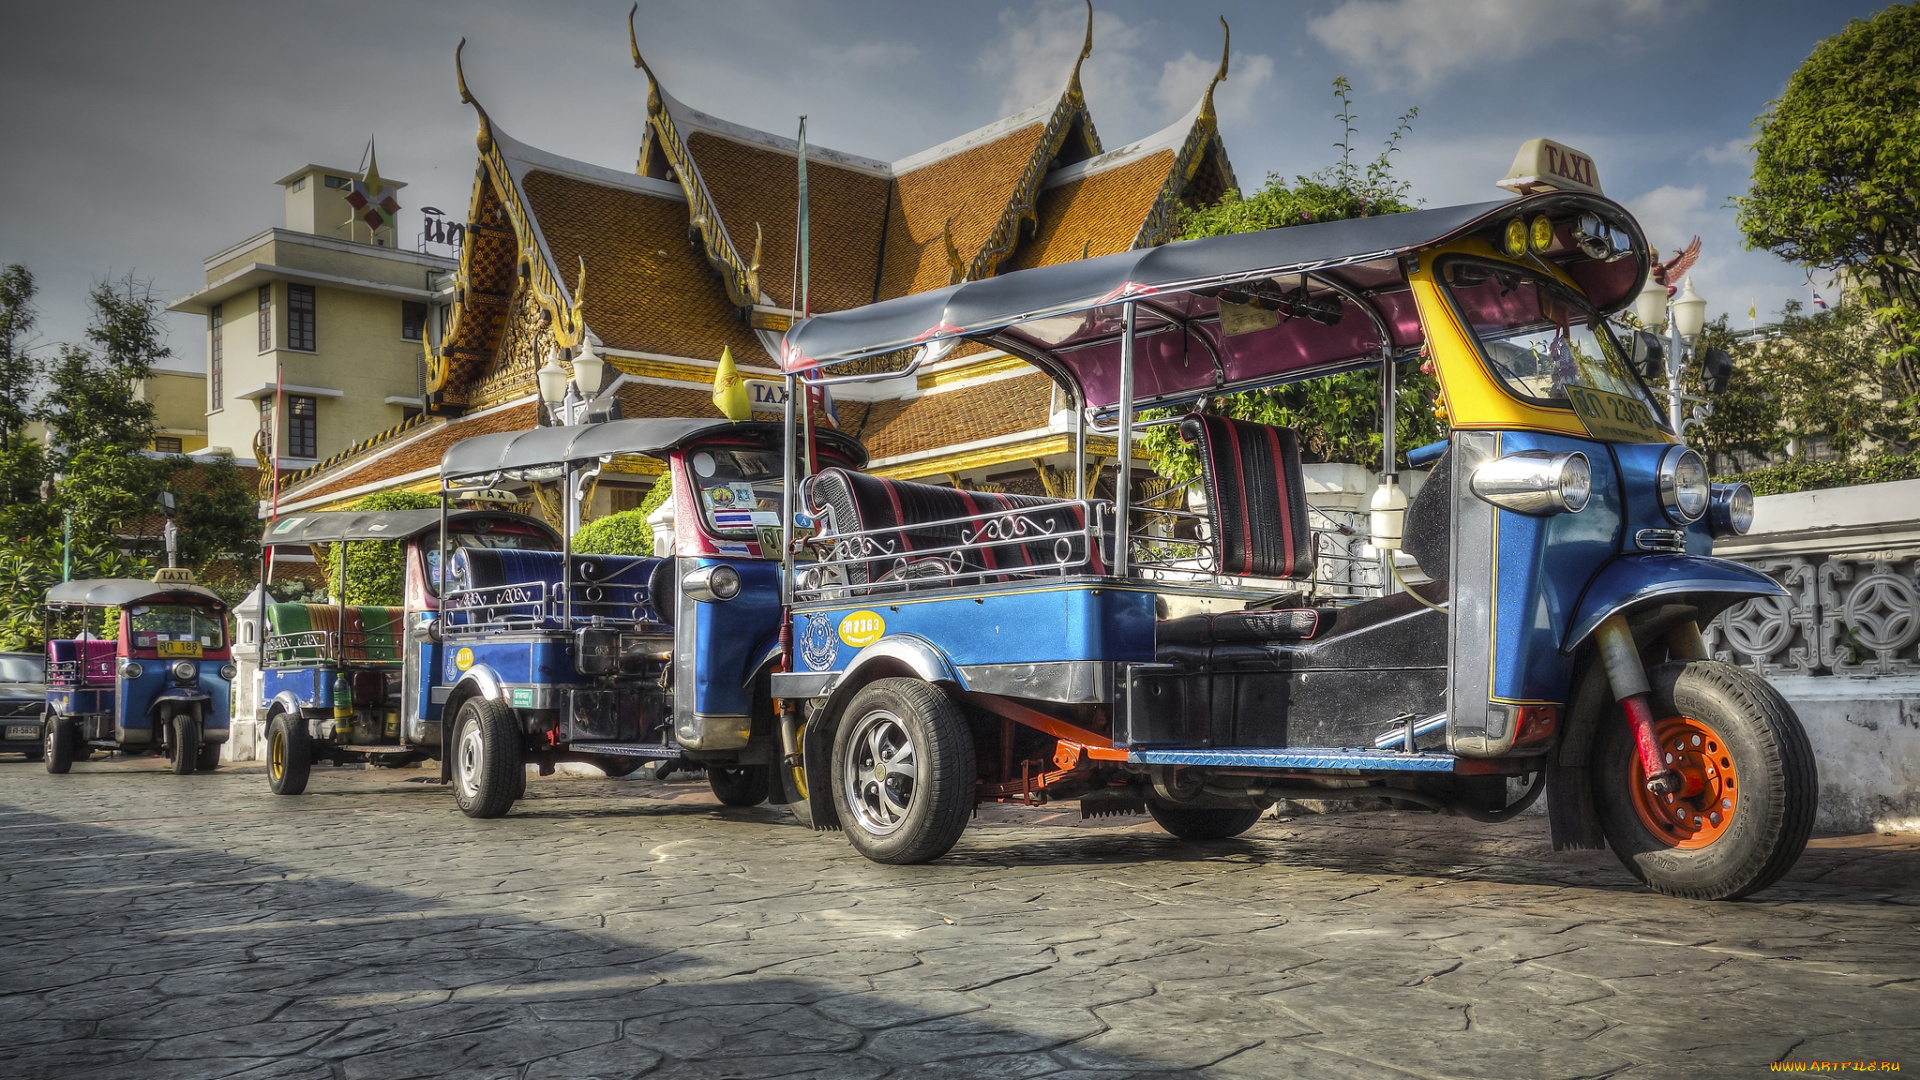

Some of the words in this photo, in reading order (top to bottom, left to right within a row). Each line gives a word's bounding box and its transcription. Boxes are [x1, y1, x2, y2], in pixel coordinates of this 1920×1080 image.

[1545, 144, 1593, 187] TAXI
[753, 384, 797, 405] TAX
[1607, 396, 1653, 430] 2363
[162, 571, 189, 581] TAXI
[853, 618, 879, 633] 2363
[181, 642, 198, 651] 188
